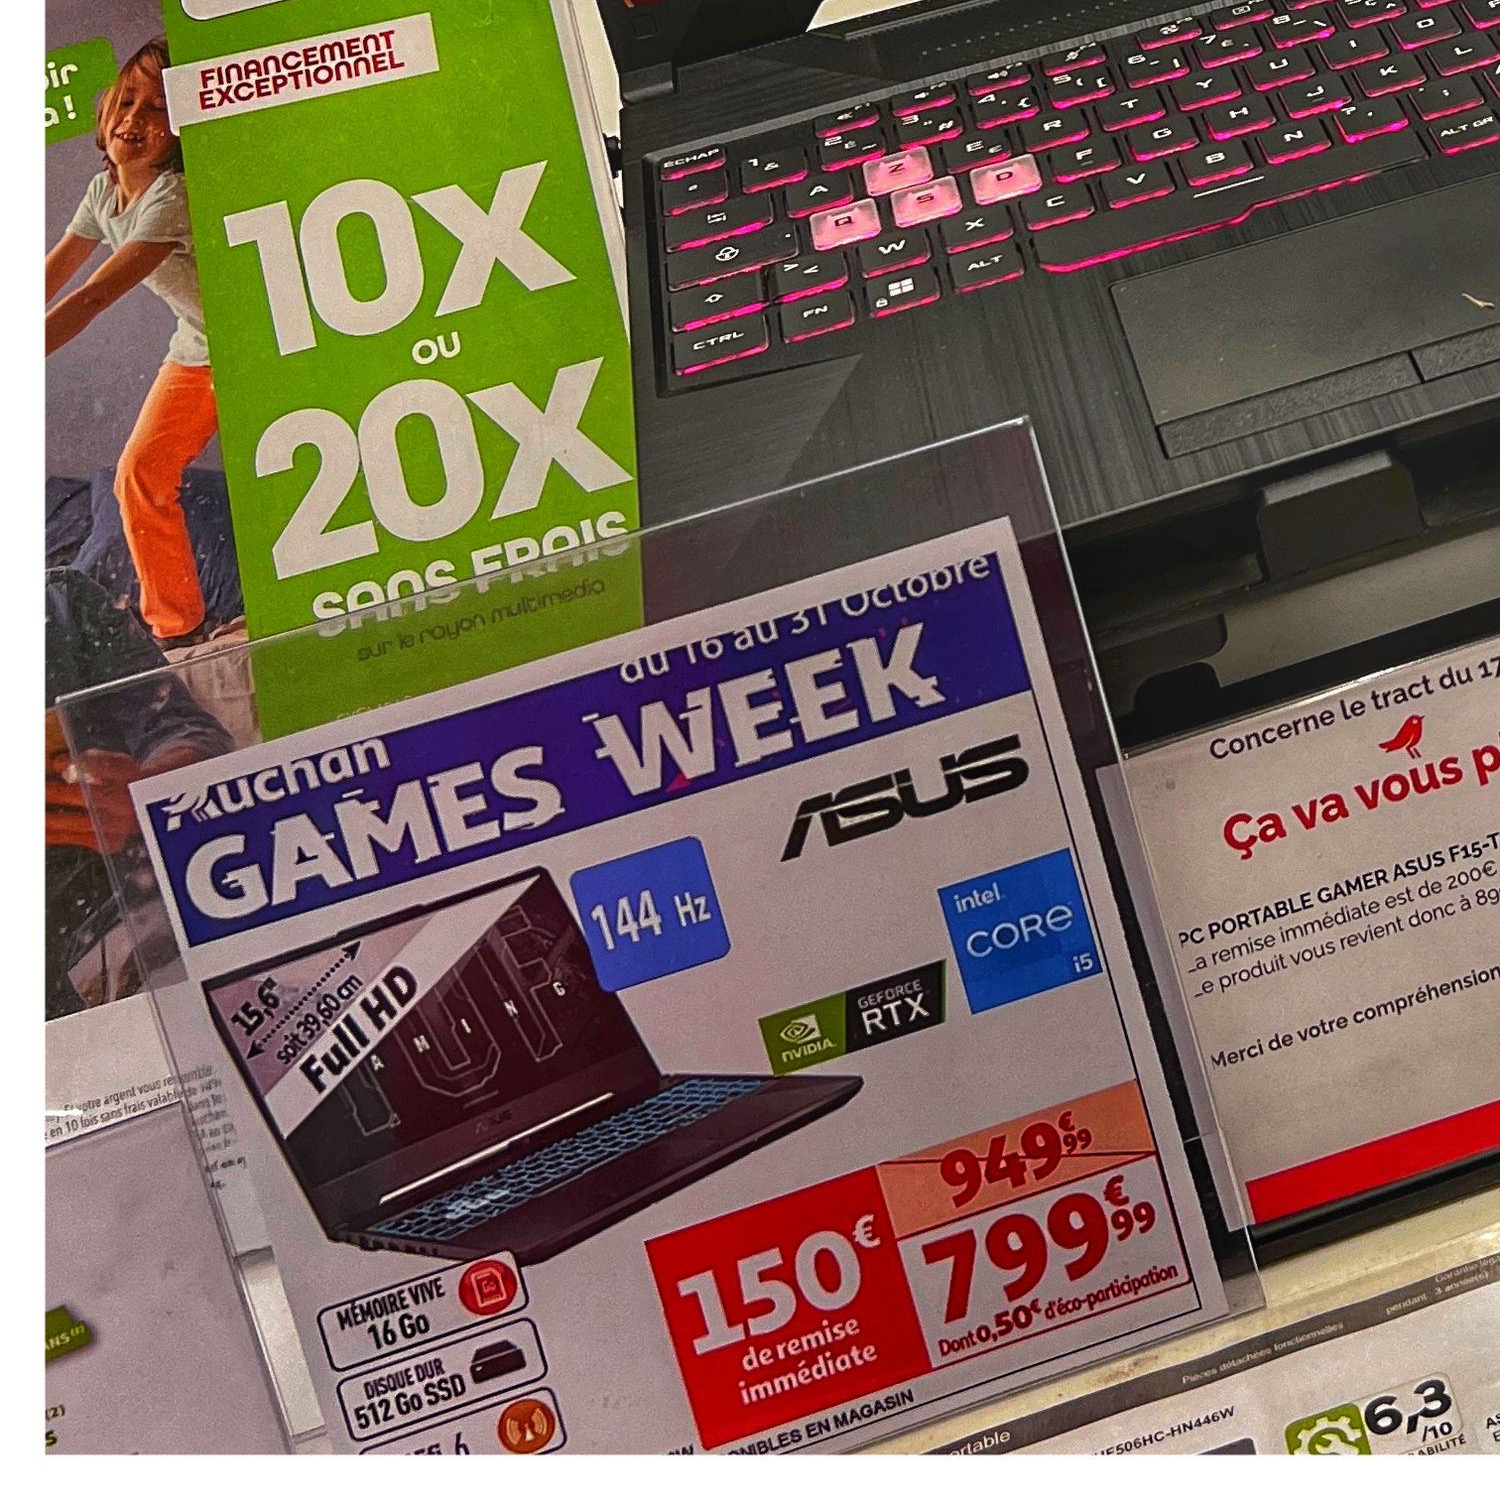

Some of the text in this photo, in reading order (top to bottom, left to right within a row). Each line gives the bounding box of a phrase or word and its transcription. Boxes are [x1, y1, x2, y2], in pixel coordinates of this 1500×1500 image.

[967, 256, 1003, 272] ALT
[411, 332, 460, 365] OU
[693, 330, 744, 352] CTRL
[1208, 713, 1336, 760] Concerne
[1370, 674, 1435, 713] tract
[161, 734, 391, 832] Auchan
[185, 622, 945, 921] GAMES WEEK
[780, 734, 1029, 863] ASUS
[1222, 811, 1287, 861] Ça
[1290, 796, 1349, 832] va
[1353, 755, 1464, 814] vous
[1317, 867, 1389, 904] GAMER
[1392, 851, 1446, 883] ASUS
[590, 889, 711, 951] 144 Hz
[857, 979, 924, 1010] GEFORCE
[862, 992, 931, 1035] RTX
[300, 964, 418, 1094] Full HD
[1296, 1014, 1348, 1044] votre
[336, 1276, 445, 1330] MÉMOIRE VIVE
[364, 1371, 415, 1400] DISQUE
[738, 1340, 878, 1404] immédiate
